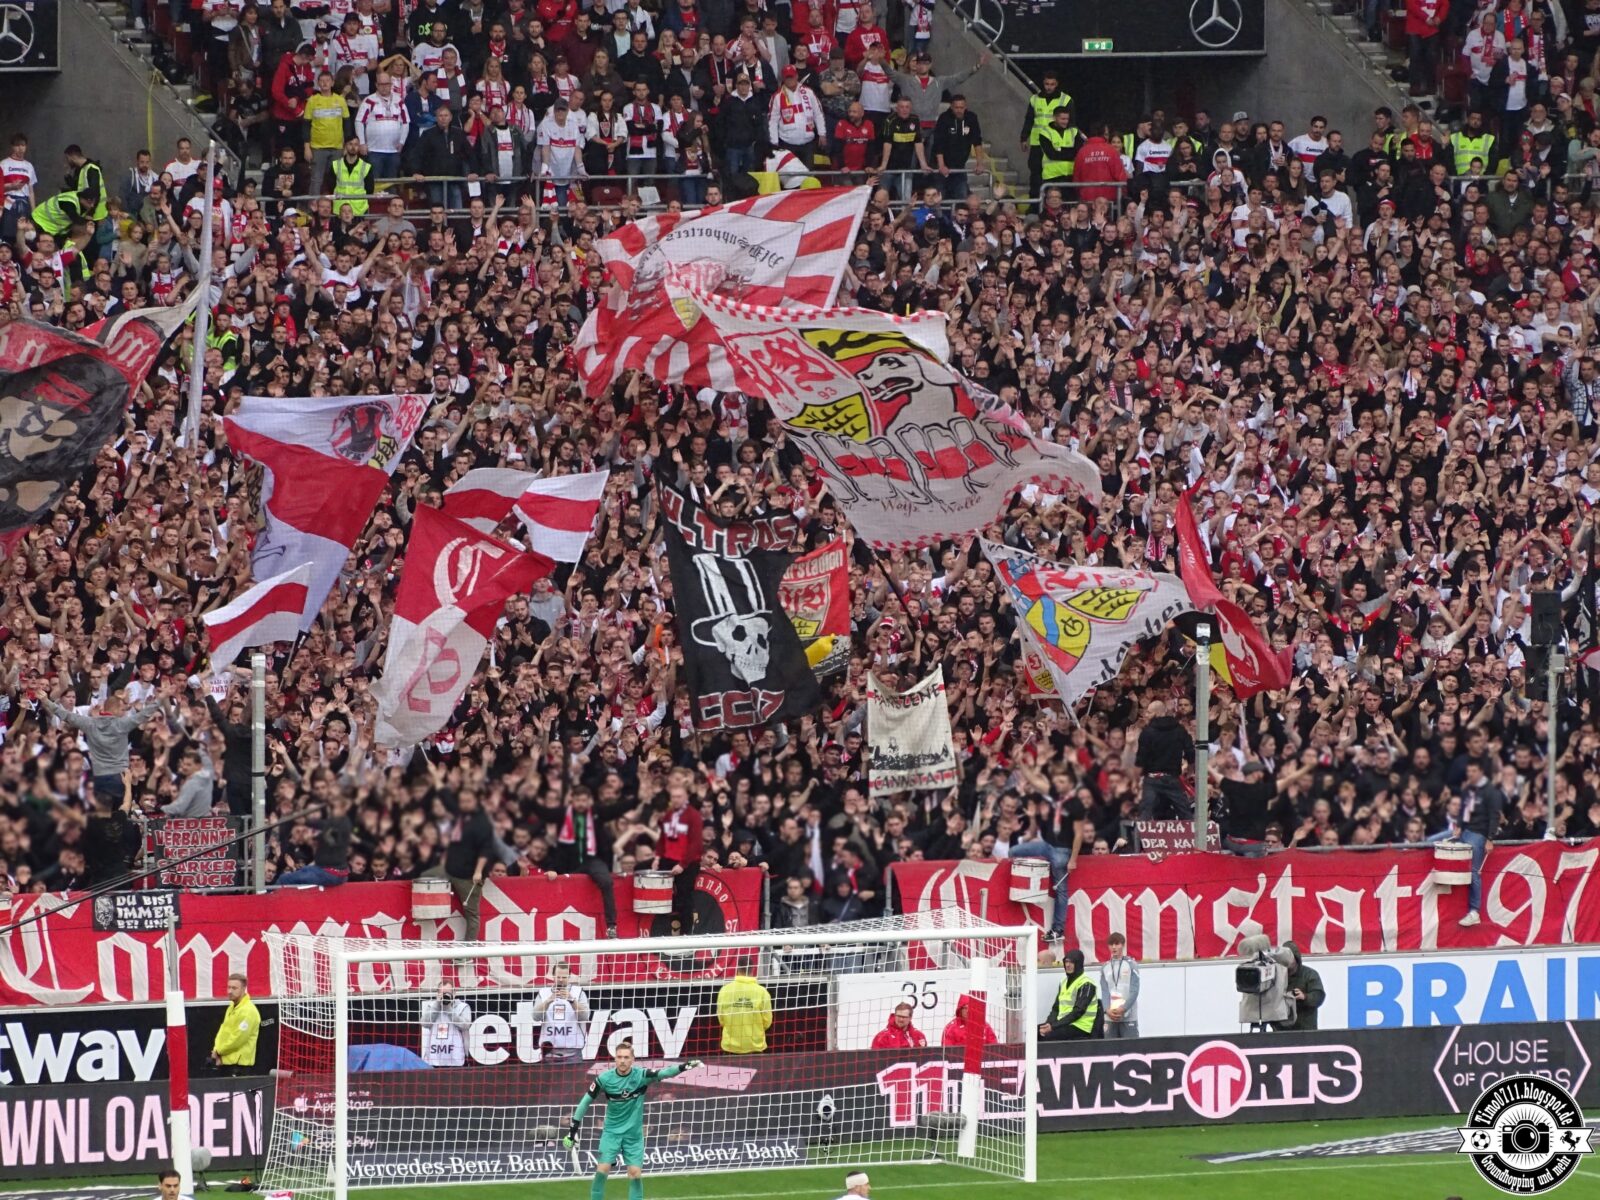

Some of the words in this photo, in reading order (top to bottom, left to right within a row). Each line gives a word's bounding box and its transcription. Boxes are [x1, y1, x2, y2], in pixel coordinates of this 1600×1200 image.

[817, 386, 838, 400] 93
[783, 548, 844, 580] arstadion
[164, 818, 227, 830] JEDER
[155, 829, 236, 847] VERBANNTE
[1141, 838, 1168, 849] DER
[116, 896, 137, 907] DU
[141, 893, 174, 906] BIST
[1486, 848, 1599, 946] 97
[116, 905, 174, 919] IMMER
[144, 918, 170, 929] UNS
[725, 918, 739, 935] 97
[901, 981, 938, 1010] 35
[546, 1025, 573, 1037] SMF
[430, 1044, 454, 1055] SMF
[1454, 1039, 1549, 1066] HOUSE
[1453, 1072, 1476, 1087] OF
[745, 1140, 799, 1159] Bank
[346, 1155, 503, 1178] Mercedes-Benz
[507, 1154, 565, 1173] Bank
